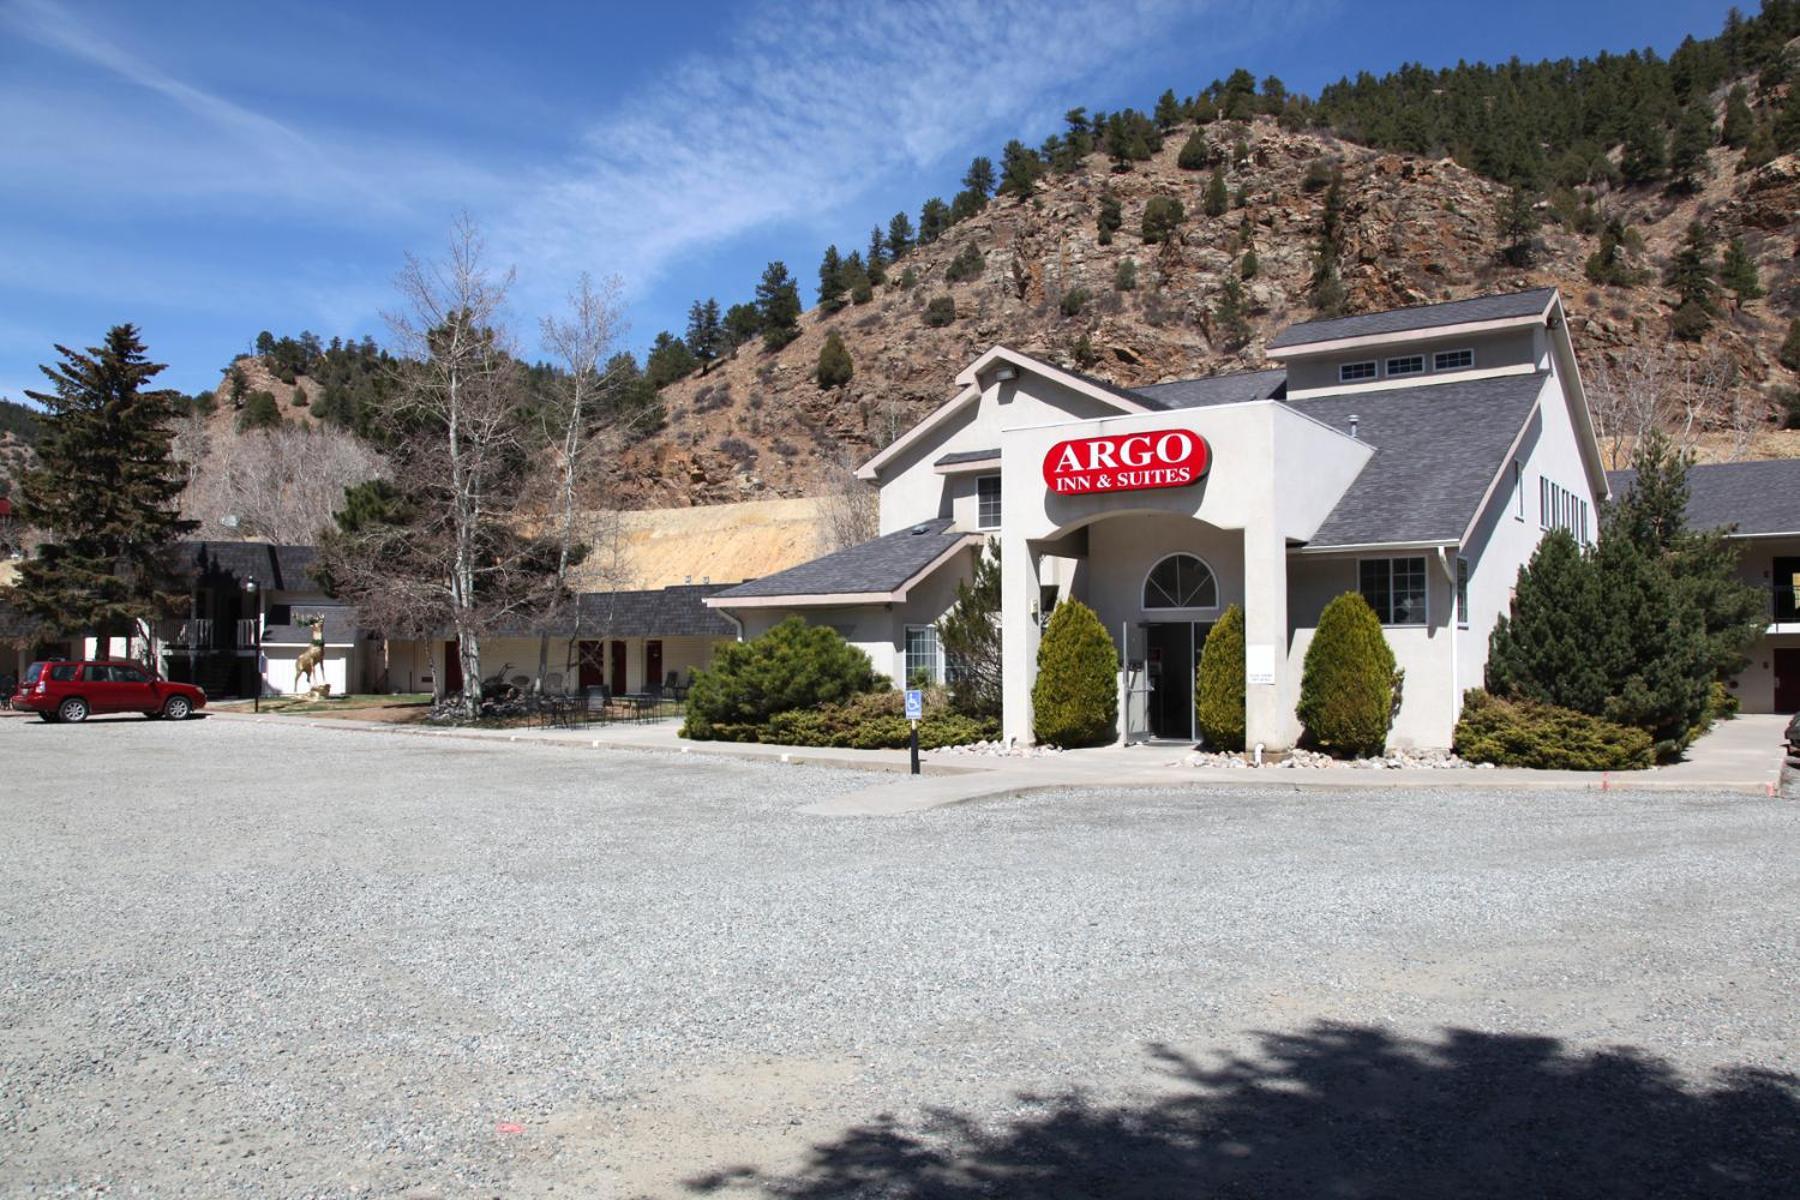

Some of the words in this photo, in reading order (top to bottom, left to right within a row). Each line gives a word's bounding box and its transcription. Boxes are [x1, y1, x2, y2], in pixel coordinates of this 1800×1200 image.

[1054, 433, 1192, 473] ARGO
[1056, 475, 1091, 492] INN
[1096, 473, 1112, 488] &
[1117, 467, 1190, 487] SUITES
